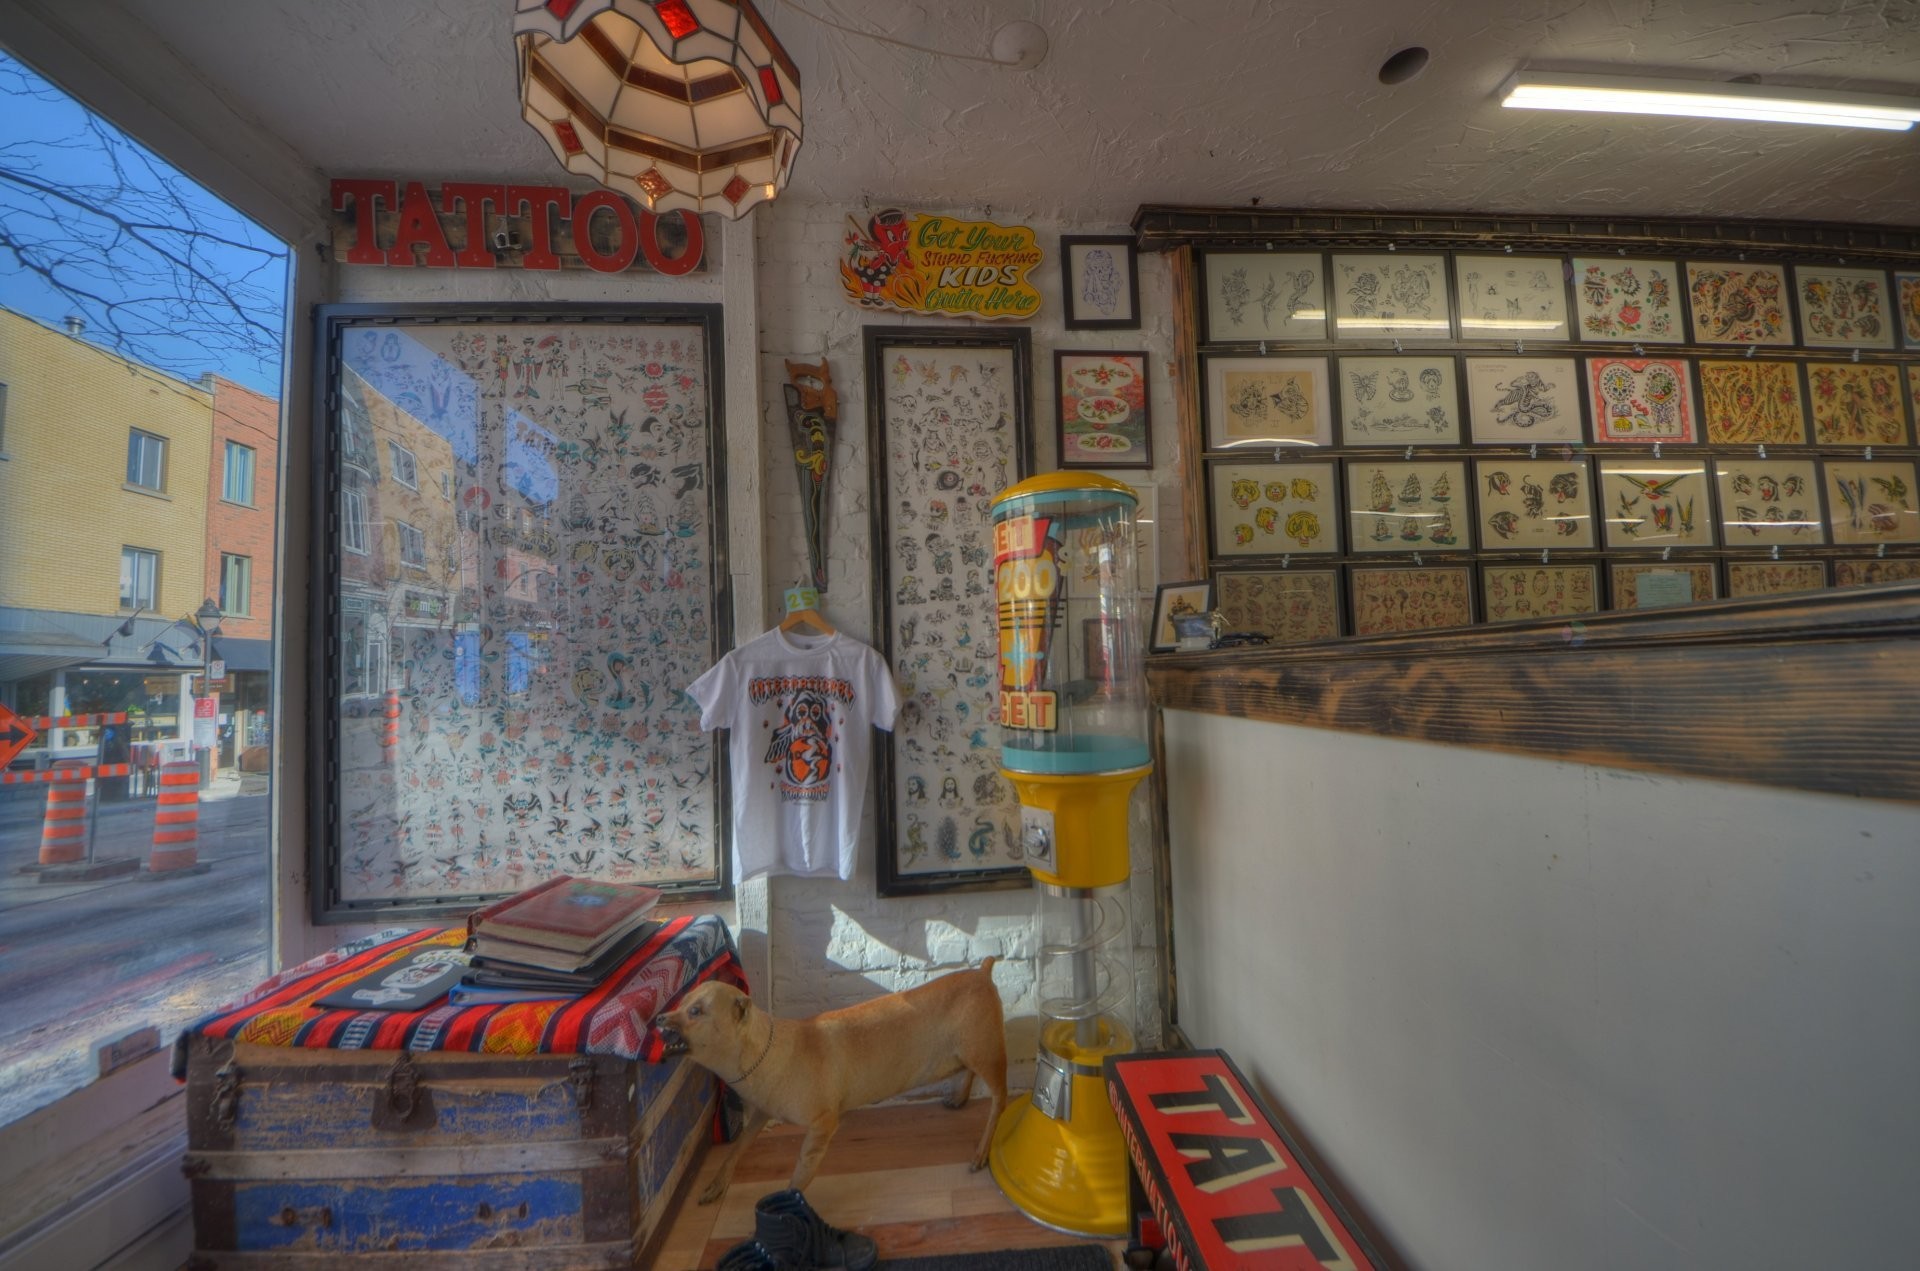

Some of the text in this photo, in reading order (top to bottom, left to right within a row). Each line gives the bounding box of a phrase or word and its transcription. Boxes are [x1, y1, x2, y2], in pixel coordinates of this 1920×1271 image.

[330, 178, 704, 276] TATTOO
[918, 219, 1026, 252] Get Your
[922, 250, 1040, 267] STUPID FUCKING
[938, 264, 1019, 288] KIDS
[983, 287, 1037, 311] Here
[993, 517, 1029, 552] ET
